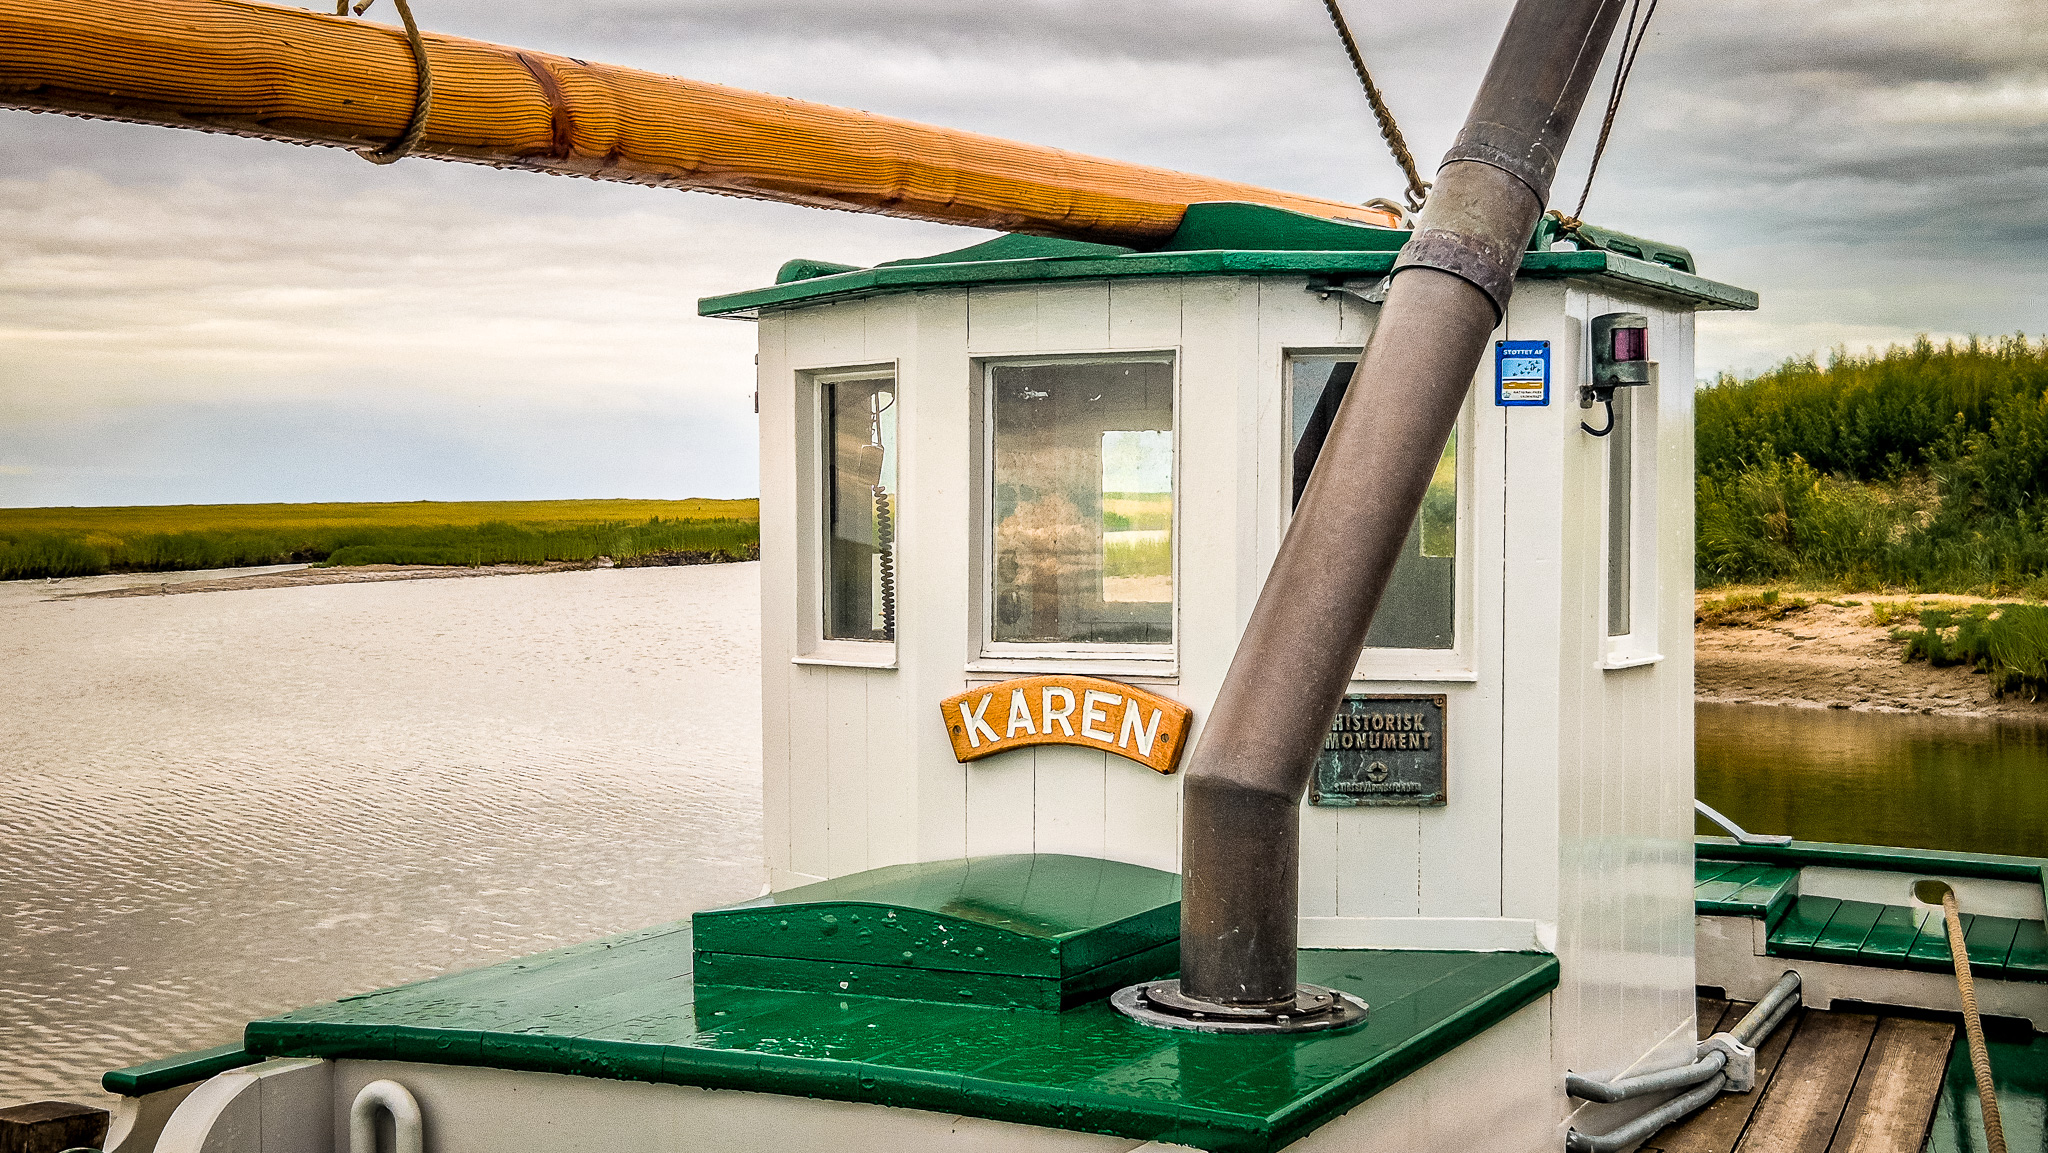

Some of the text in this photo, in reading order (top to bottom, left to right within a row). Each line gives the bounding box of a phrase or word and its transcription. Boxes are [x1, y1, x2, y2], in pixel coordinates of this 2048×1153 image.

[959, 686, 1162, 757] KAREN
[1332, 713, 1425, 731] HISTORISK
[1325, 731, 1432, 749] MONUMENT
